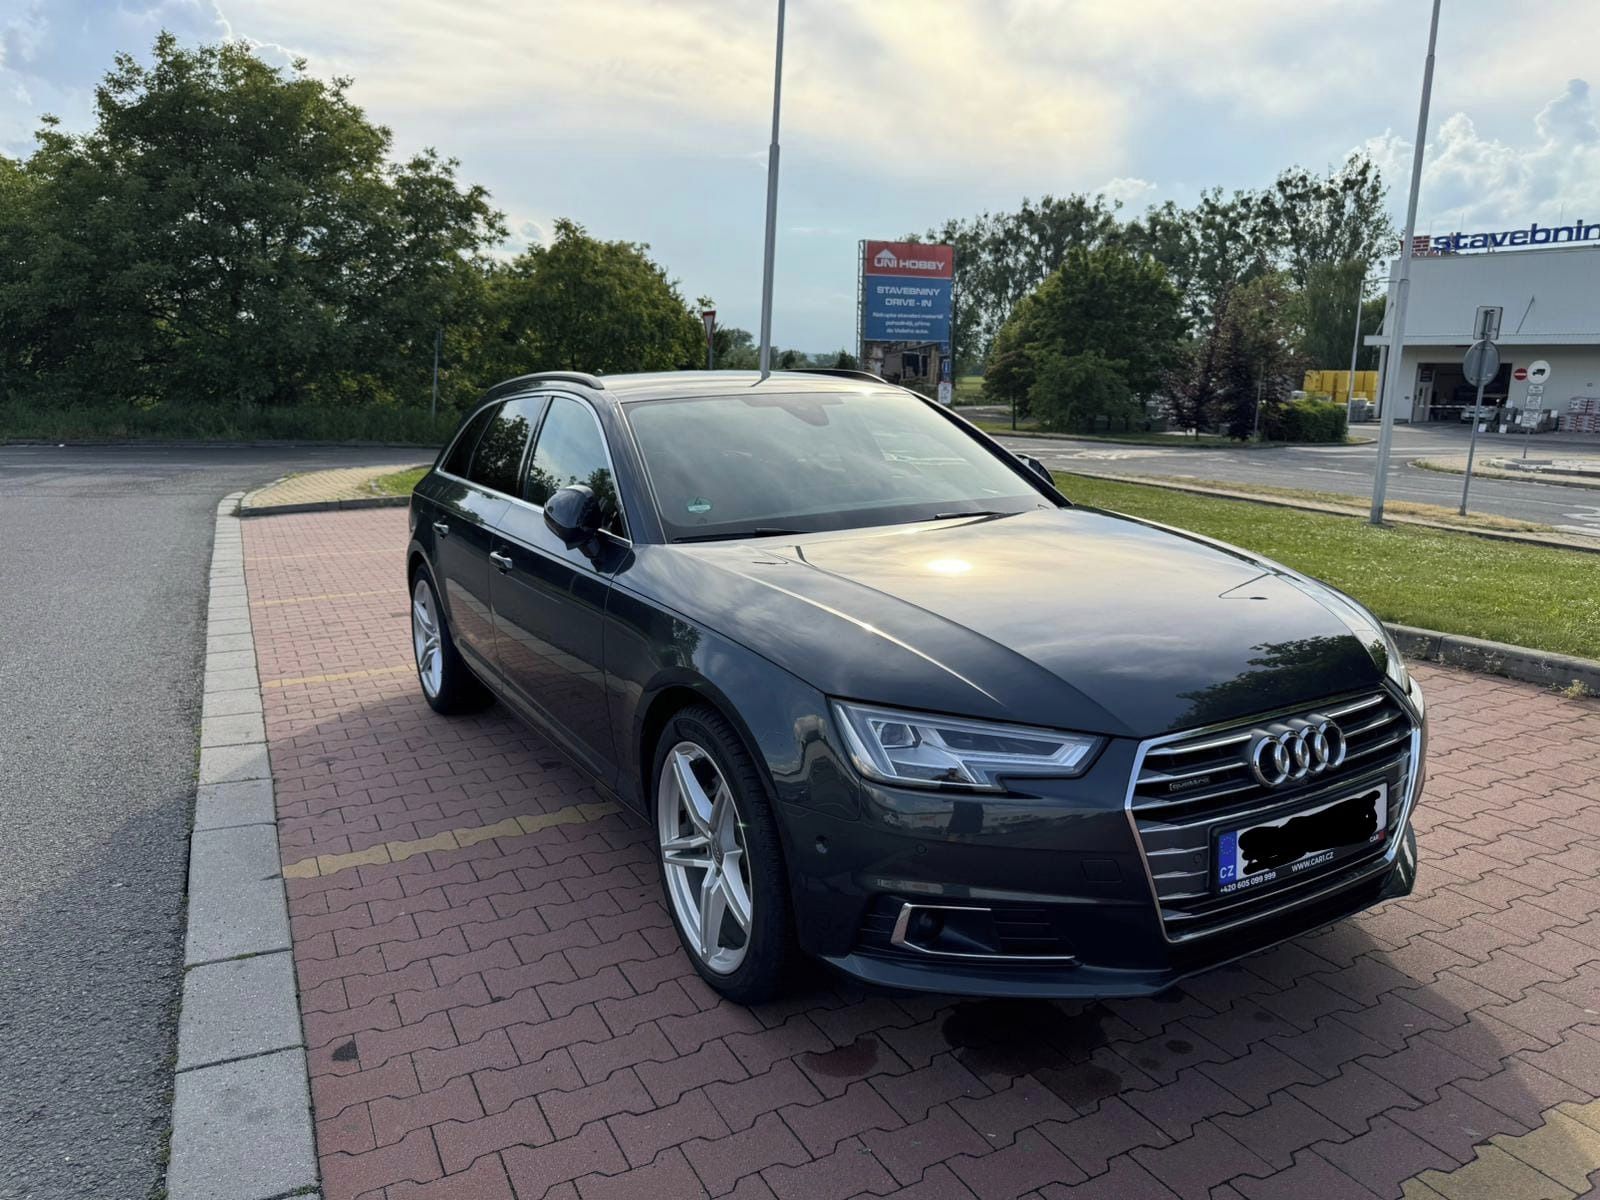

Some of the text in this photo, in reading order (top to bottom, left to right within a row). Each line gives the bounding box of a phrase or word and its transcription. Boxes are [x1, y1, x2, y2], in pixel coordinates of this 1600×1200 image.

[1433, 219, 1600, 252] stavebnin
[874, 257, 945, 270] UNI HOBBY
[876, 286, 940, 296] STAVEBNINY
[885, 298, 915, 306] DRIVE
[921, 299, 932, 307] IN
[1220, 865, 1234, 879] CZ
[1237, 880, 1250, 889] 605
[1264, 872, 1276, 881] 999
